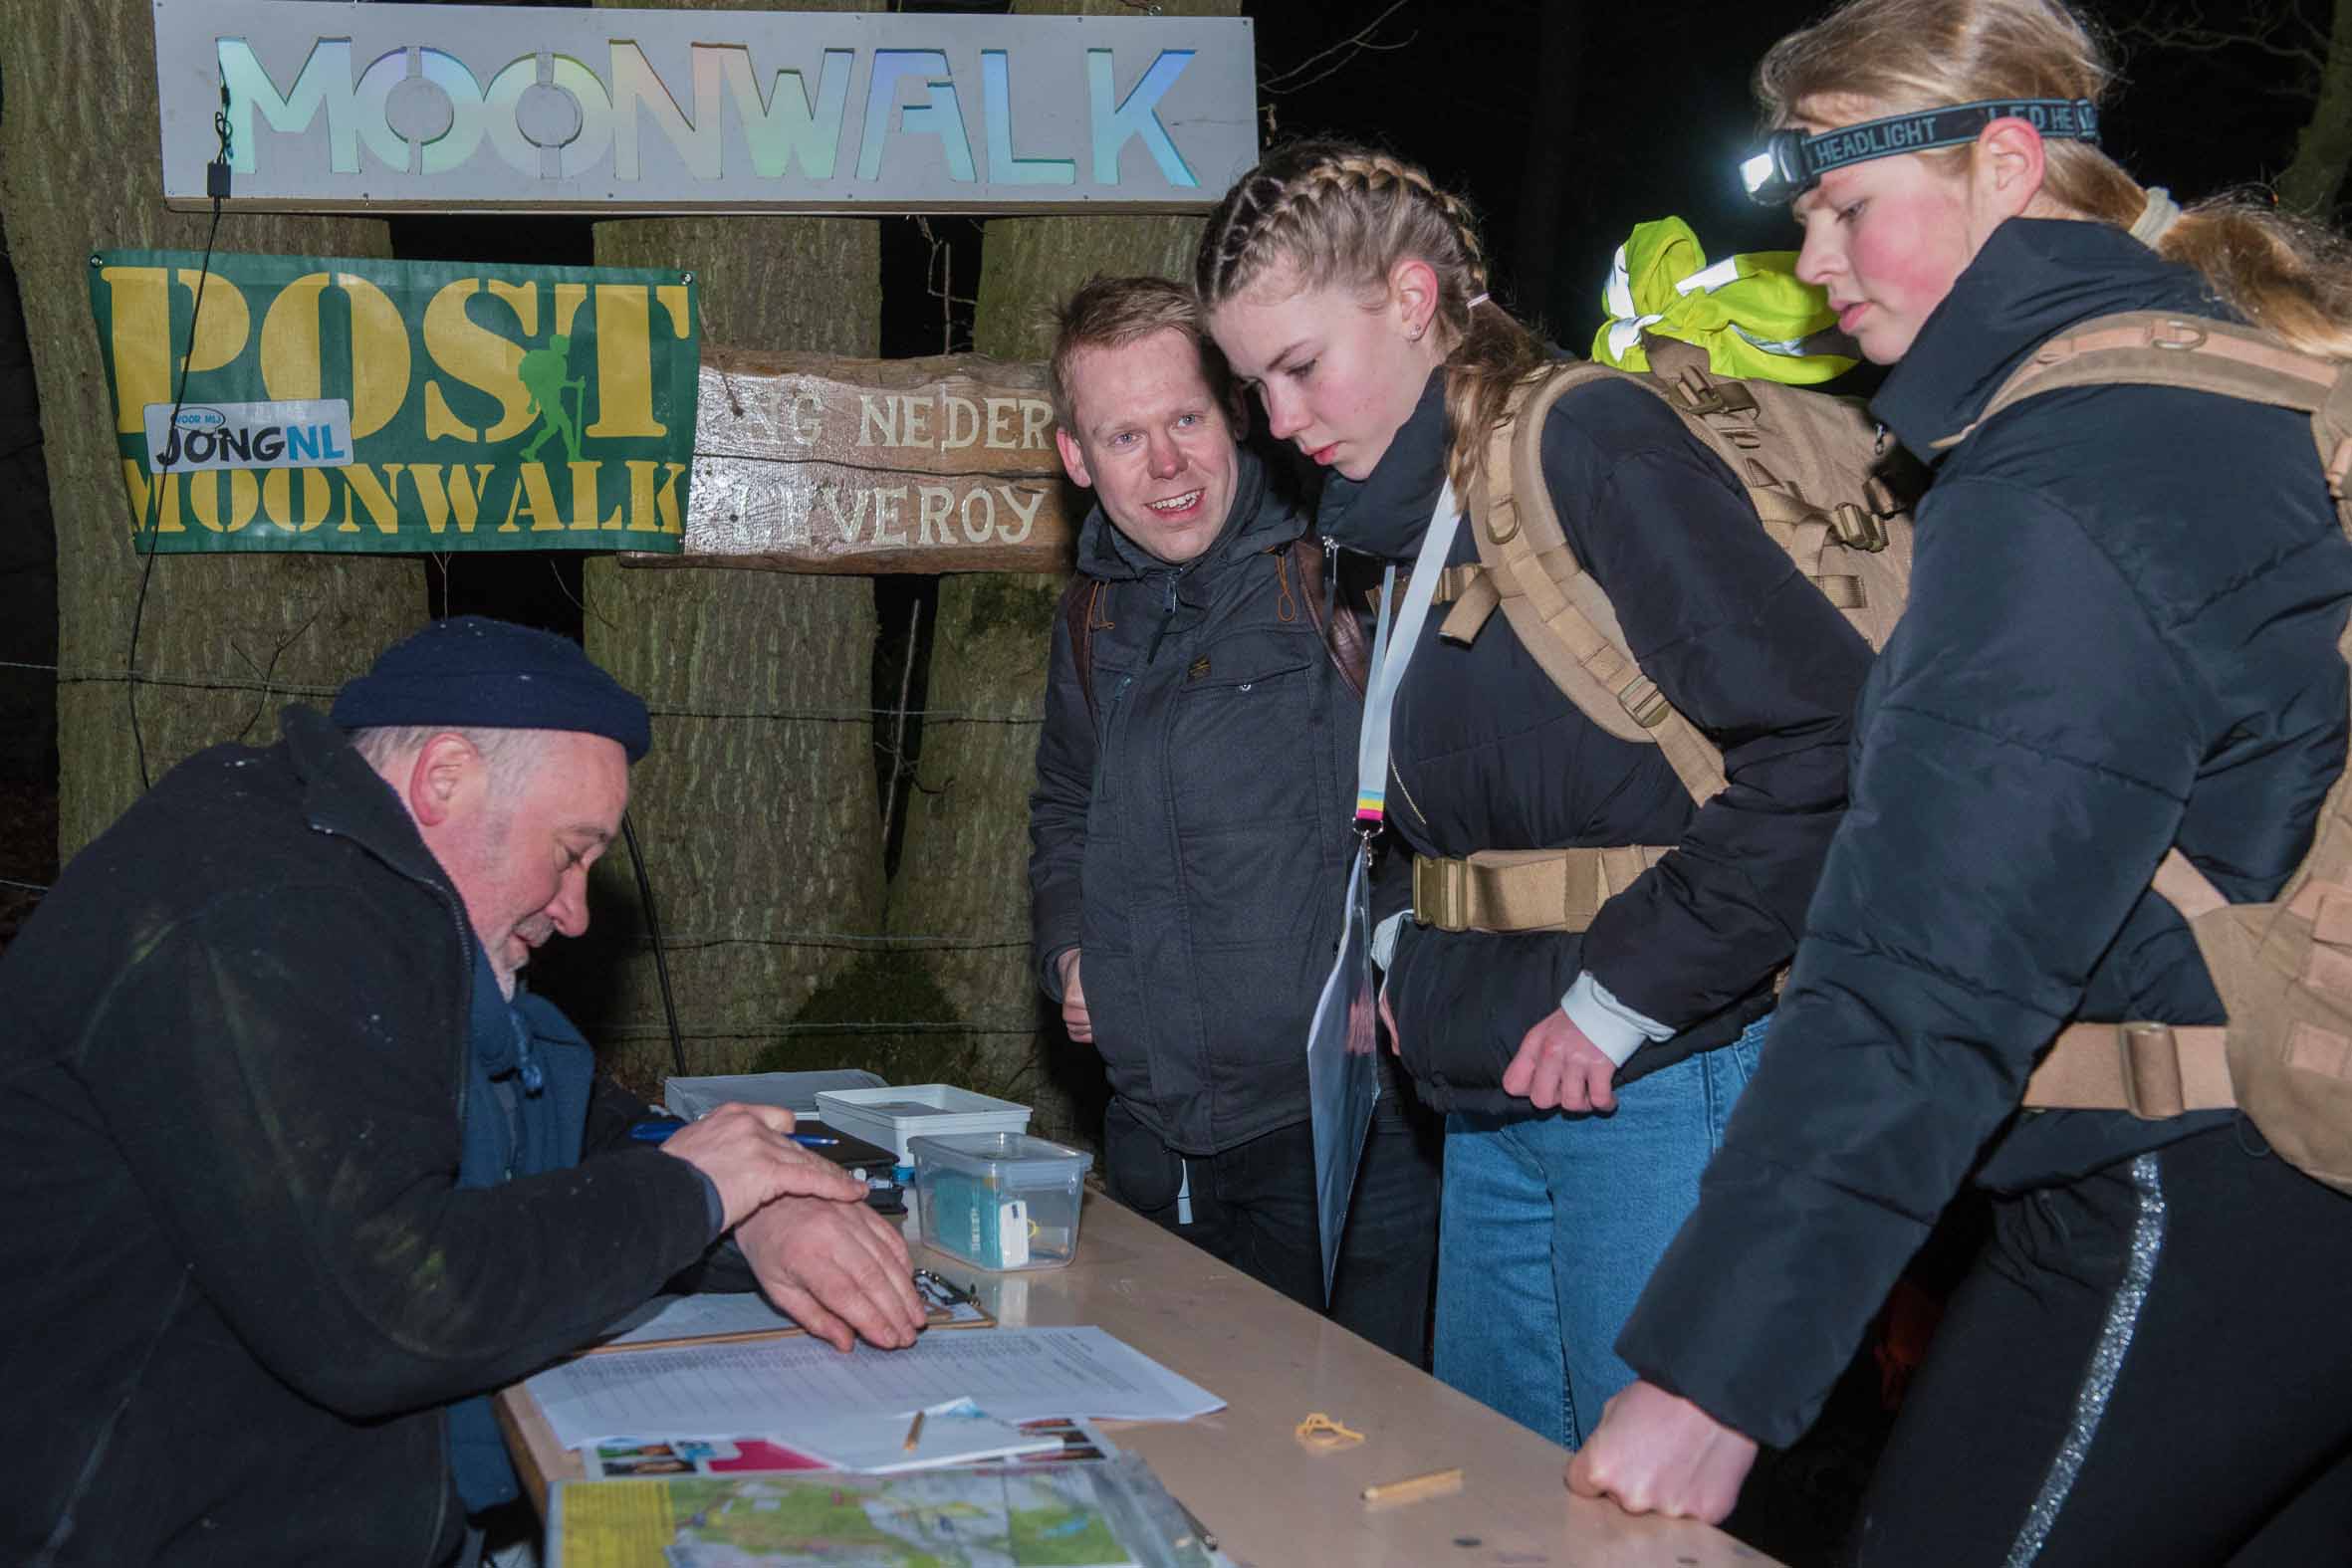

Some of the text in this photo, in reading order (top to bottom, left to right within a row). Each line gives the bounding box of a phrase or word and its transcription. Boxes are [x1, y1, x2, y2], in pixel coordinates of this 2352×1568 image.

[215, 37, 1200, 187] MOONWALK
[1815, 117, 1936, 165] HEADLIGHT
[101, 266, 689, 444] POST
[156, 423, 345, 466] JONGNL
[121, 459, 687, 535] MOONWALK
